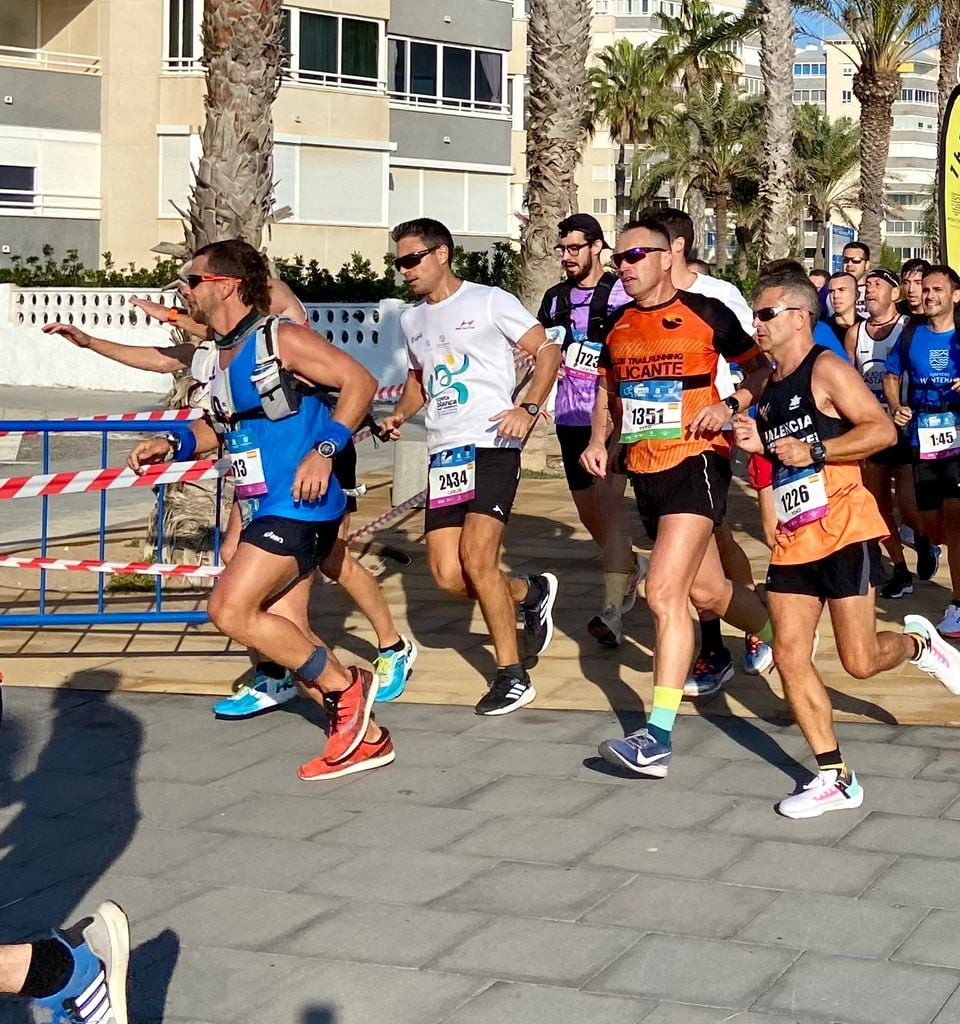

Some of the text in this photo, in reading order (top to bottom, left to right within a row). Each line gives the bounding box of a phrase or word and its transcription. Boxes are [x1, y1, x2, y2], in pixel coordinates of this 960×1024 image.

[950, 164, 959, 179] 1
[632, 407, 664, 425] 1351
[930, 431, 953, 446] 1:45
[231, 458, 248, 477] 13
[439, 470, 468, 490] 2434
[781, 485, 810, 513] 1226
